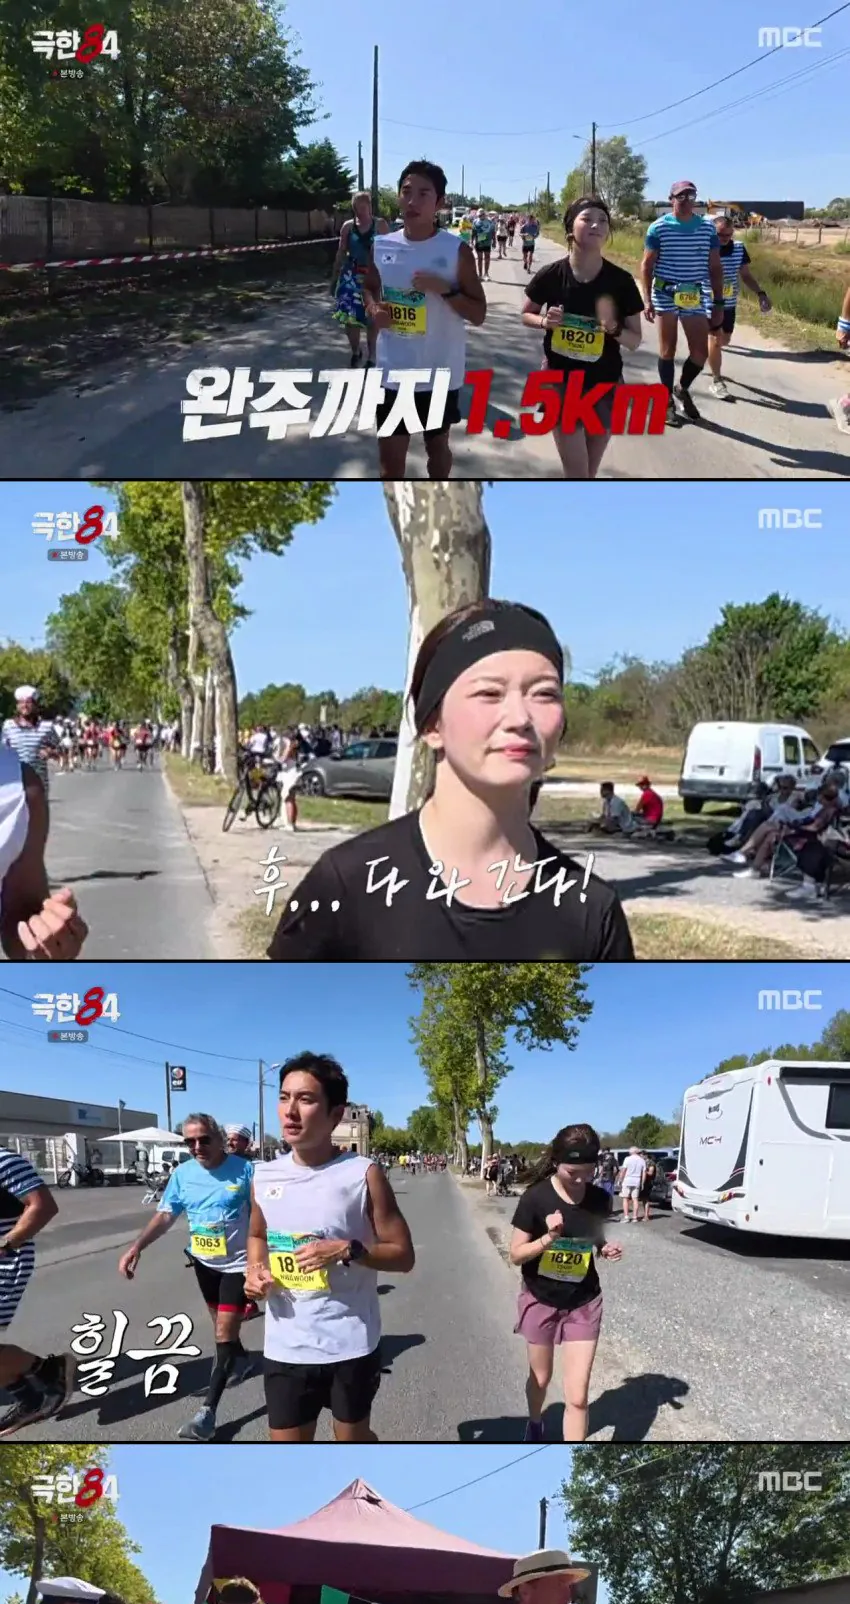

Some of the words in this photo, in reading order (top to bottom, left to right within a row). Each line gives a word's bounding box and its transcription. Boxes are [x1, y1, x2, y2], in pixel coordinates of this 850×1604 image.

[389, 306, 416, 321] 1816
[560, 328, 595, 345] 1820
[195, 1237, 221, 1248] 5063
[550, 1252, 583, 1266] 1820
